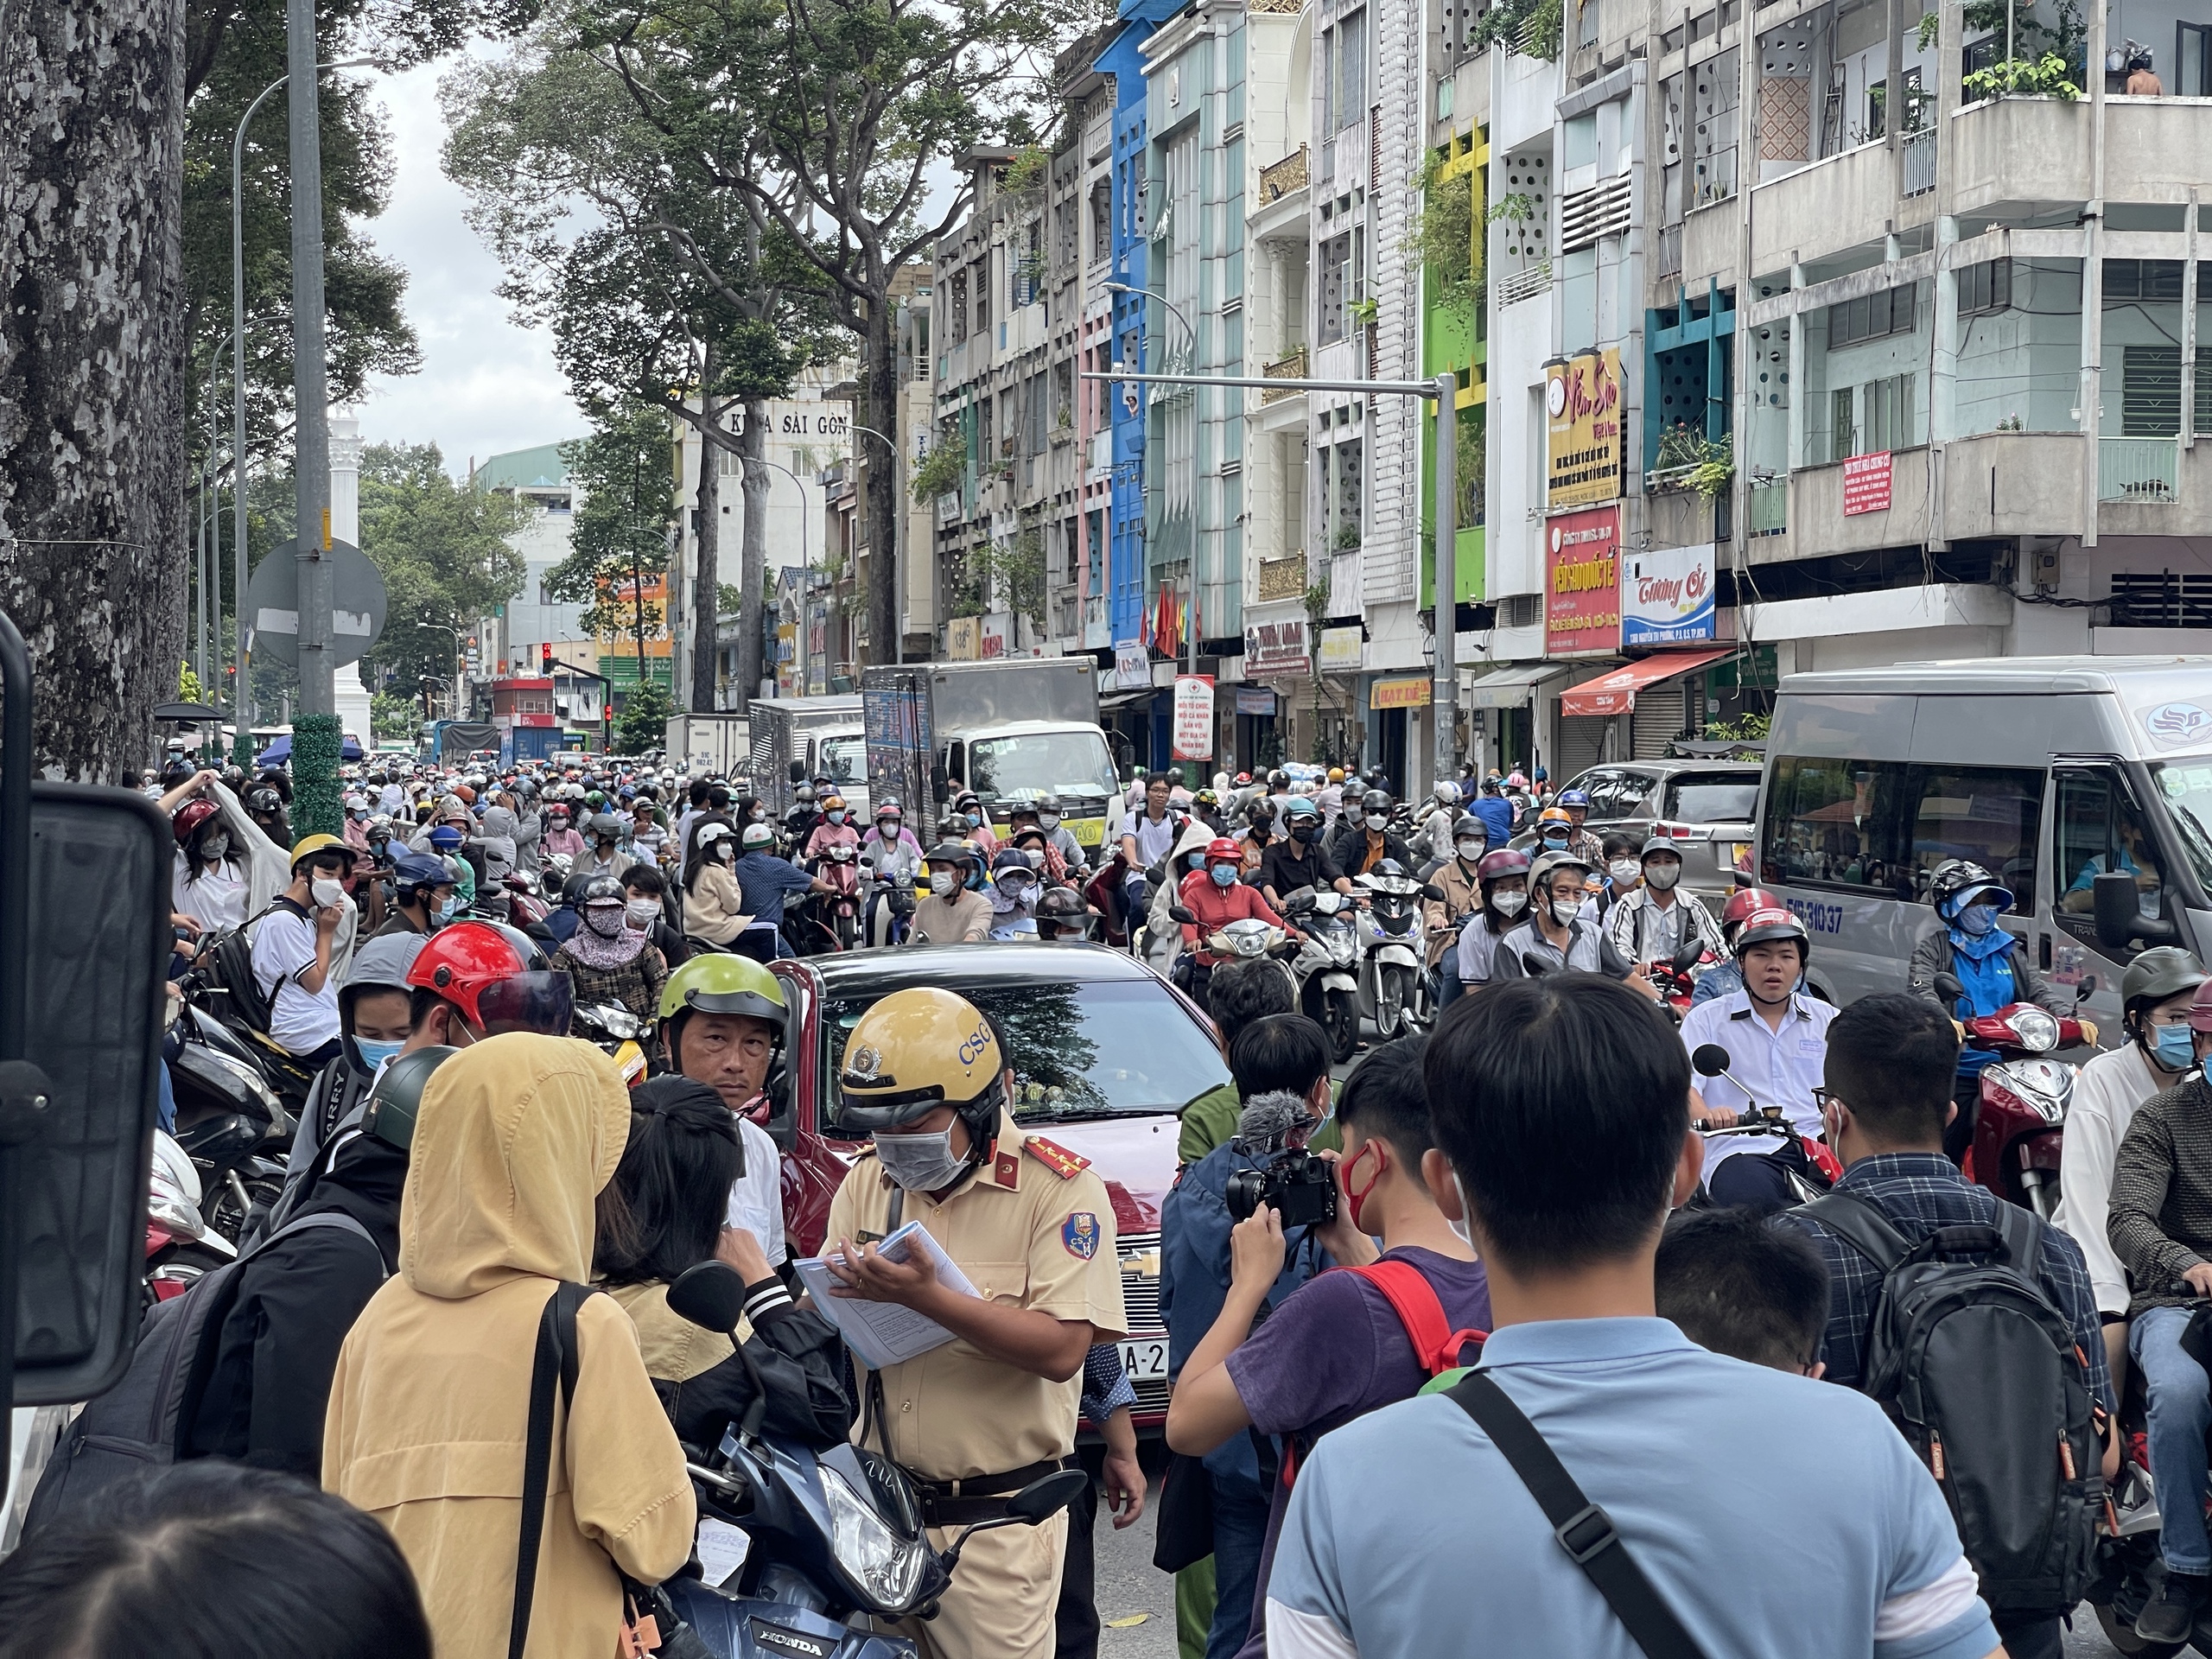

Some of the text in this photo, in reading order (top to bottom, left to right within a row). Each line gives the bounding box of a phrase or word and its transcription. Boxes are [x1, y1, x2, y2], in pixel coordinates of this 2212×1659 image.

[731, 411, 848, 435] KA SÀI GÒN
[1379, 687, 1402, 705] HẠT
[1075, 822, 1096, 842] ÁO
[958, 1022, 991, 1066] CSG
[325, 1072, 345, 1141] ARRY
[760, 1630, 823, 1657] HONDA
